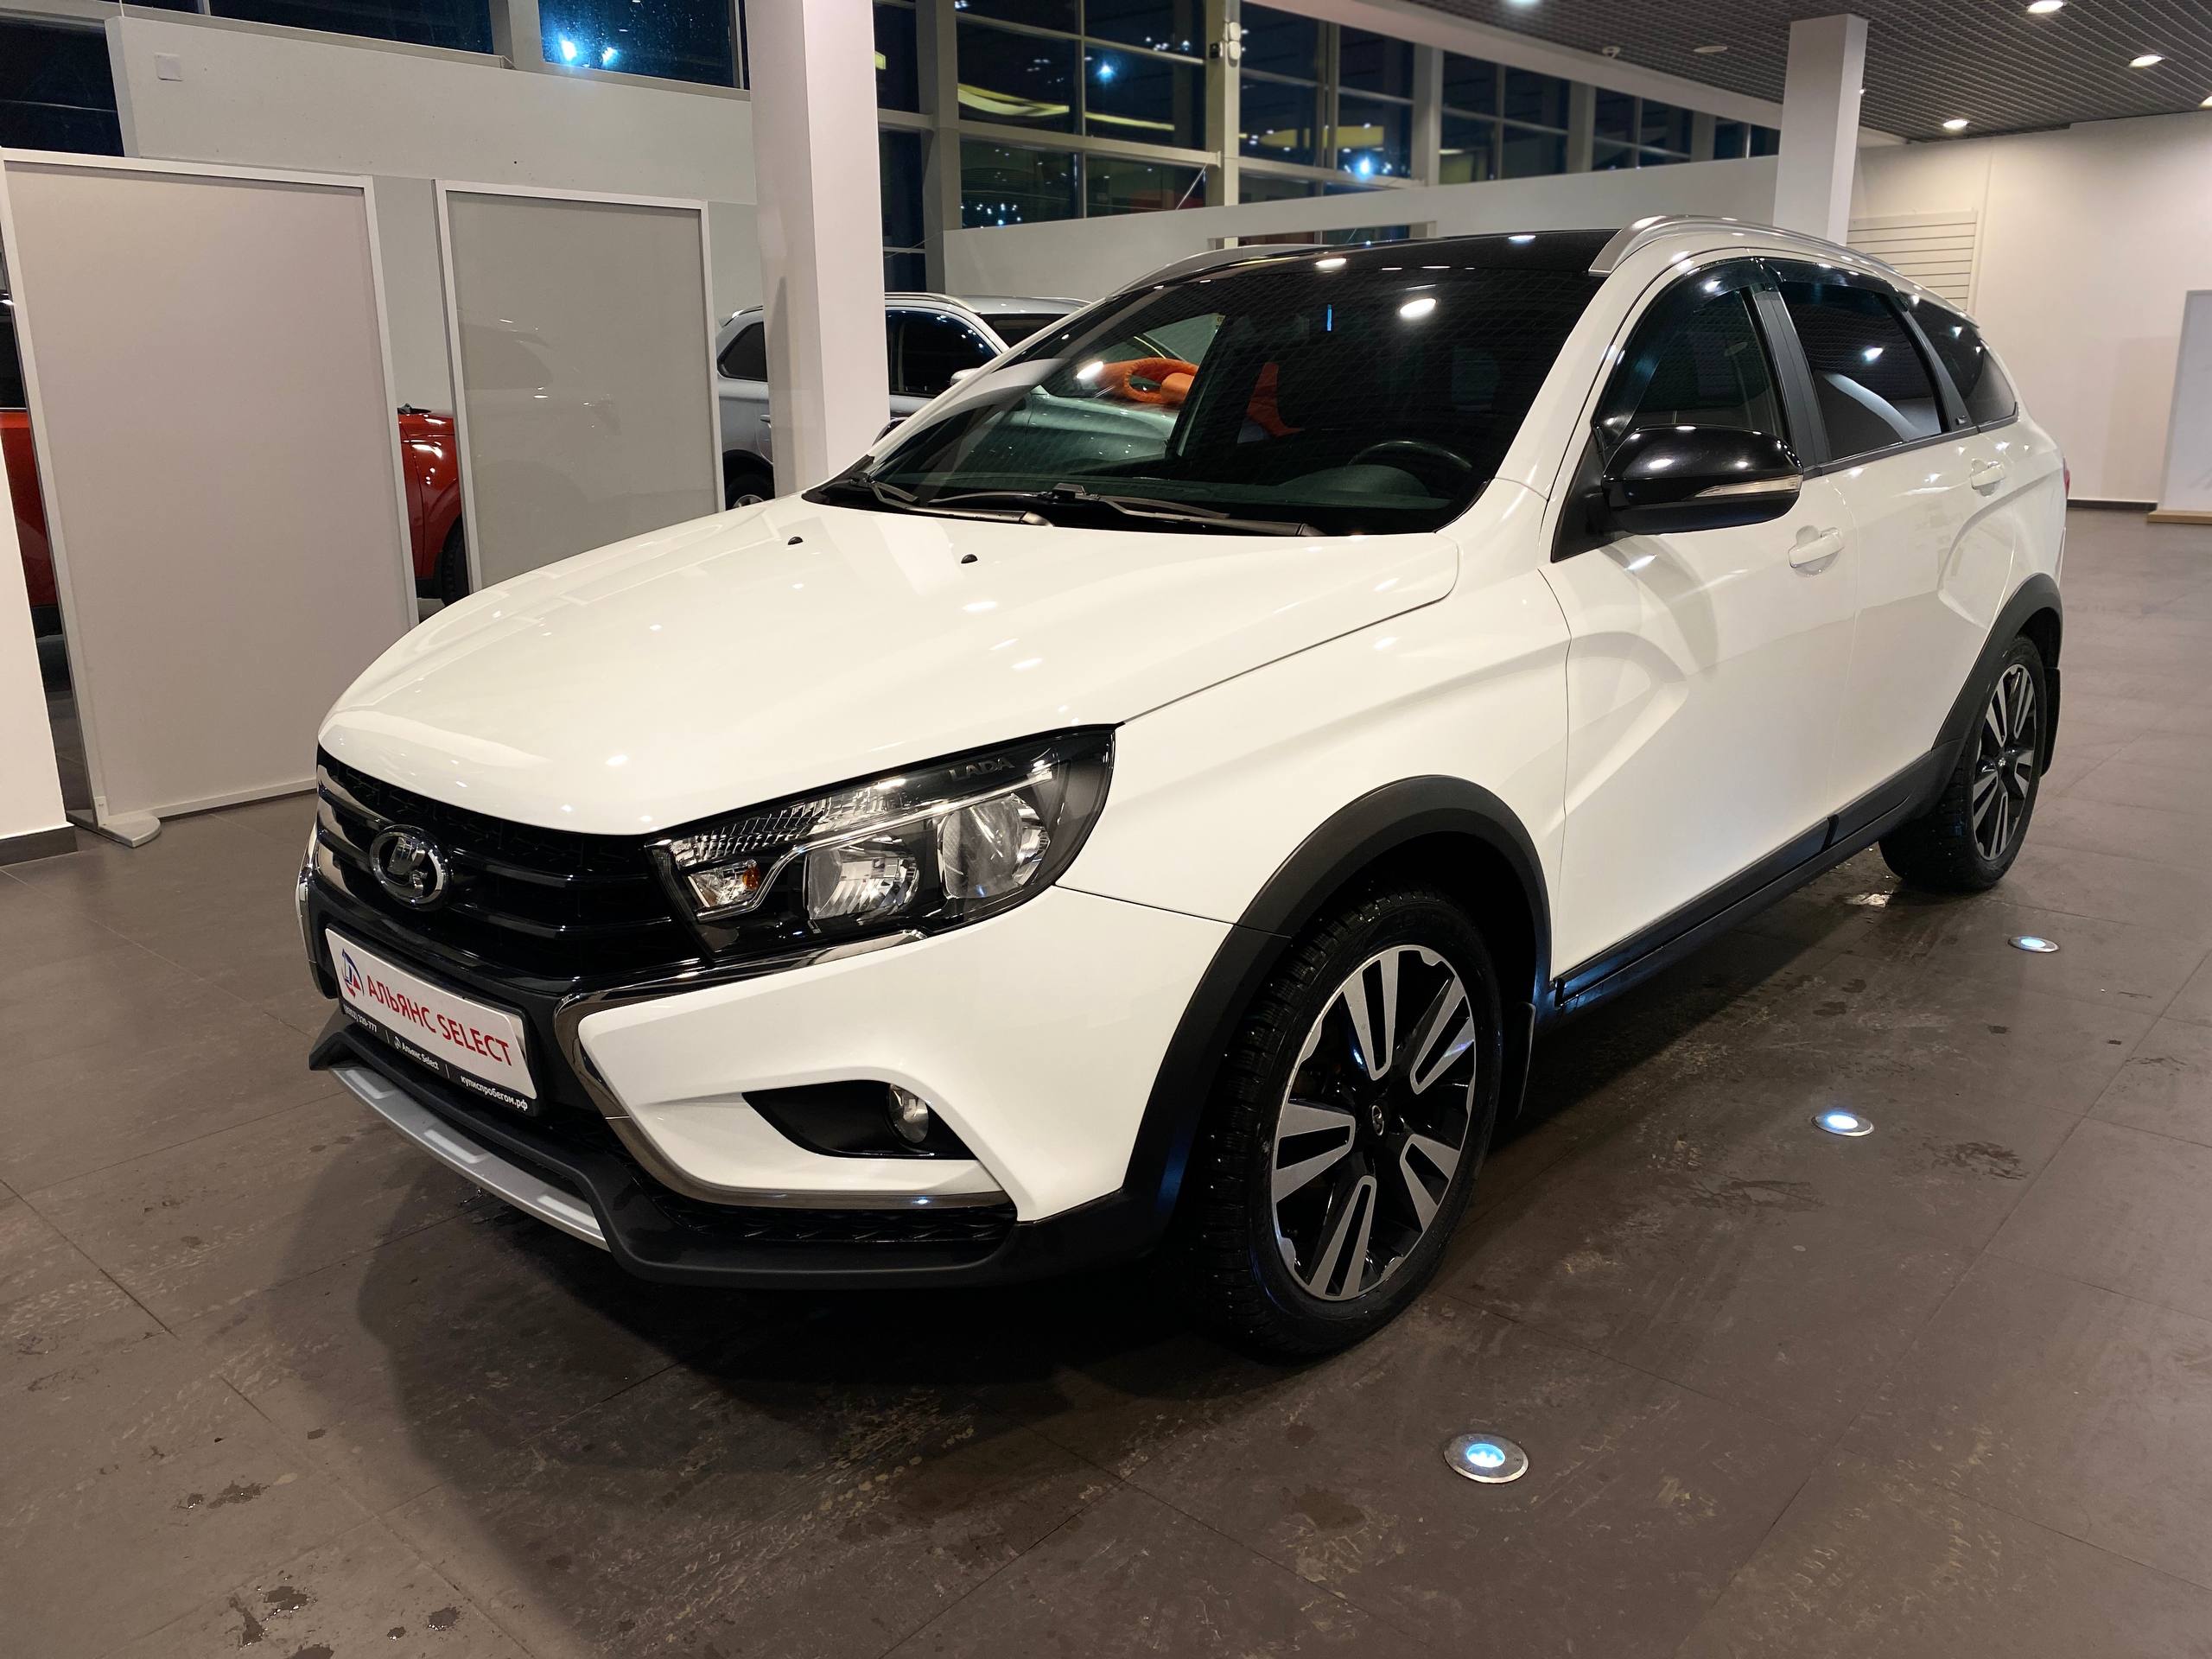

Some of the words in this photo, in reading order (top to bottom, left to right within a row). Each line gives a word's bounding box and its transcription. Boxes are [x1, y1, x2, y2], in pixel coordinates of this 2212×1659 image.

[949, 758, 1015, 781] LADA
[367, 975, 436, 1033] АЛЬЯНС
[436, 1014, 512, 1066] SELECT
[421, 1053, 440, 1071] Select
